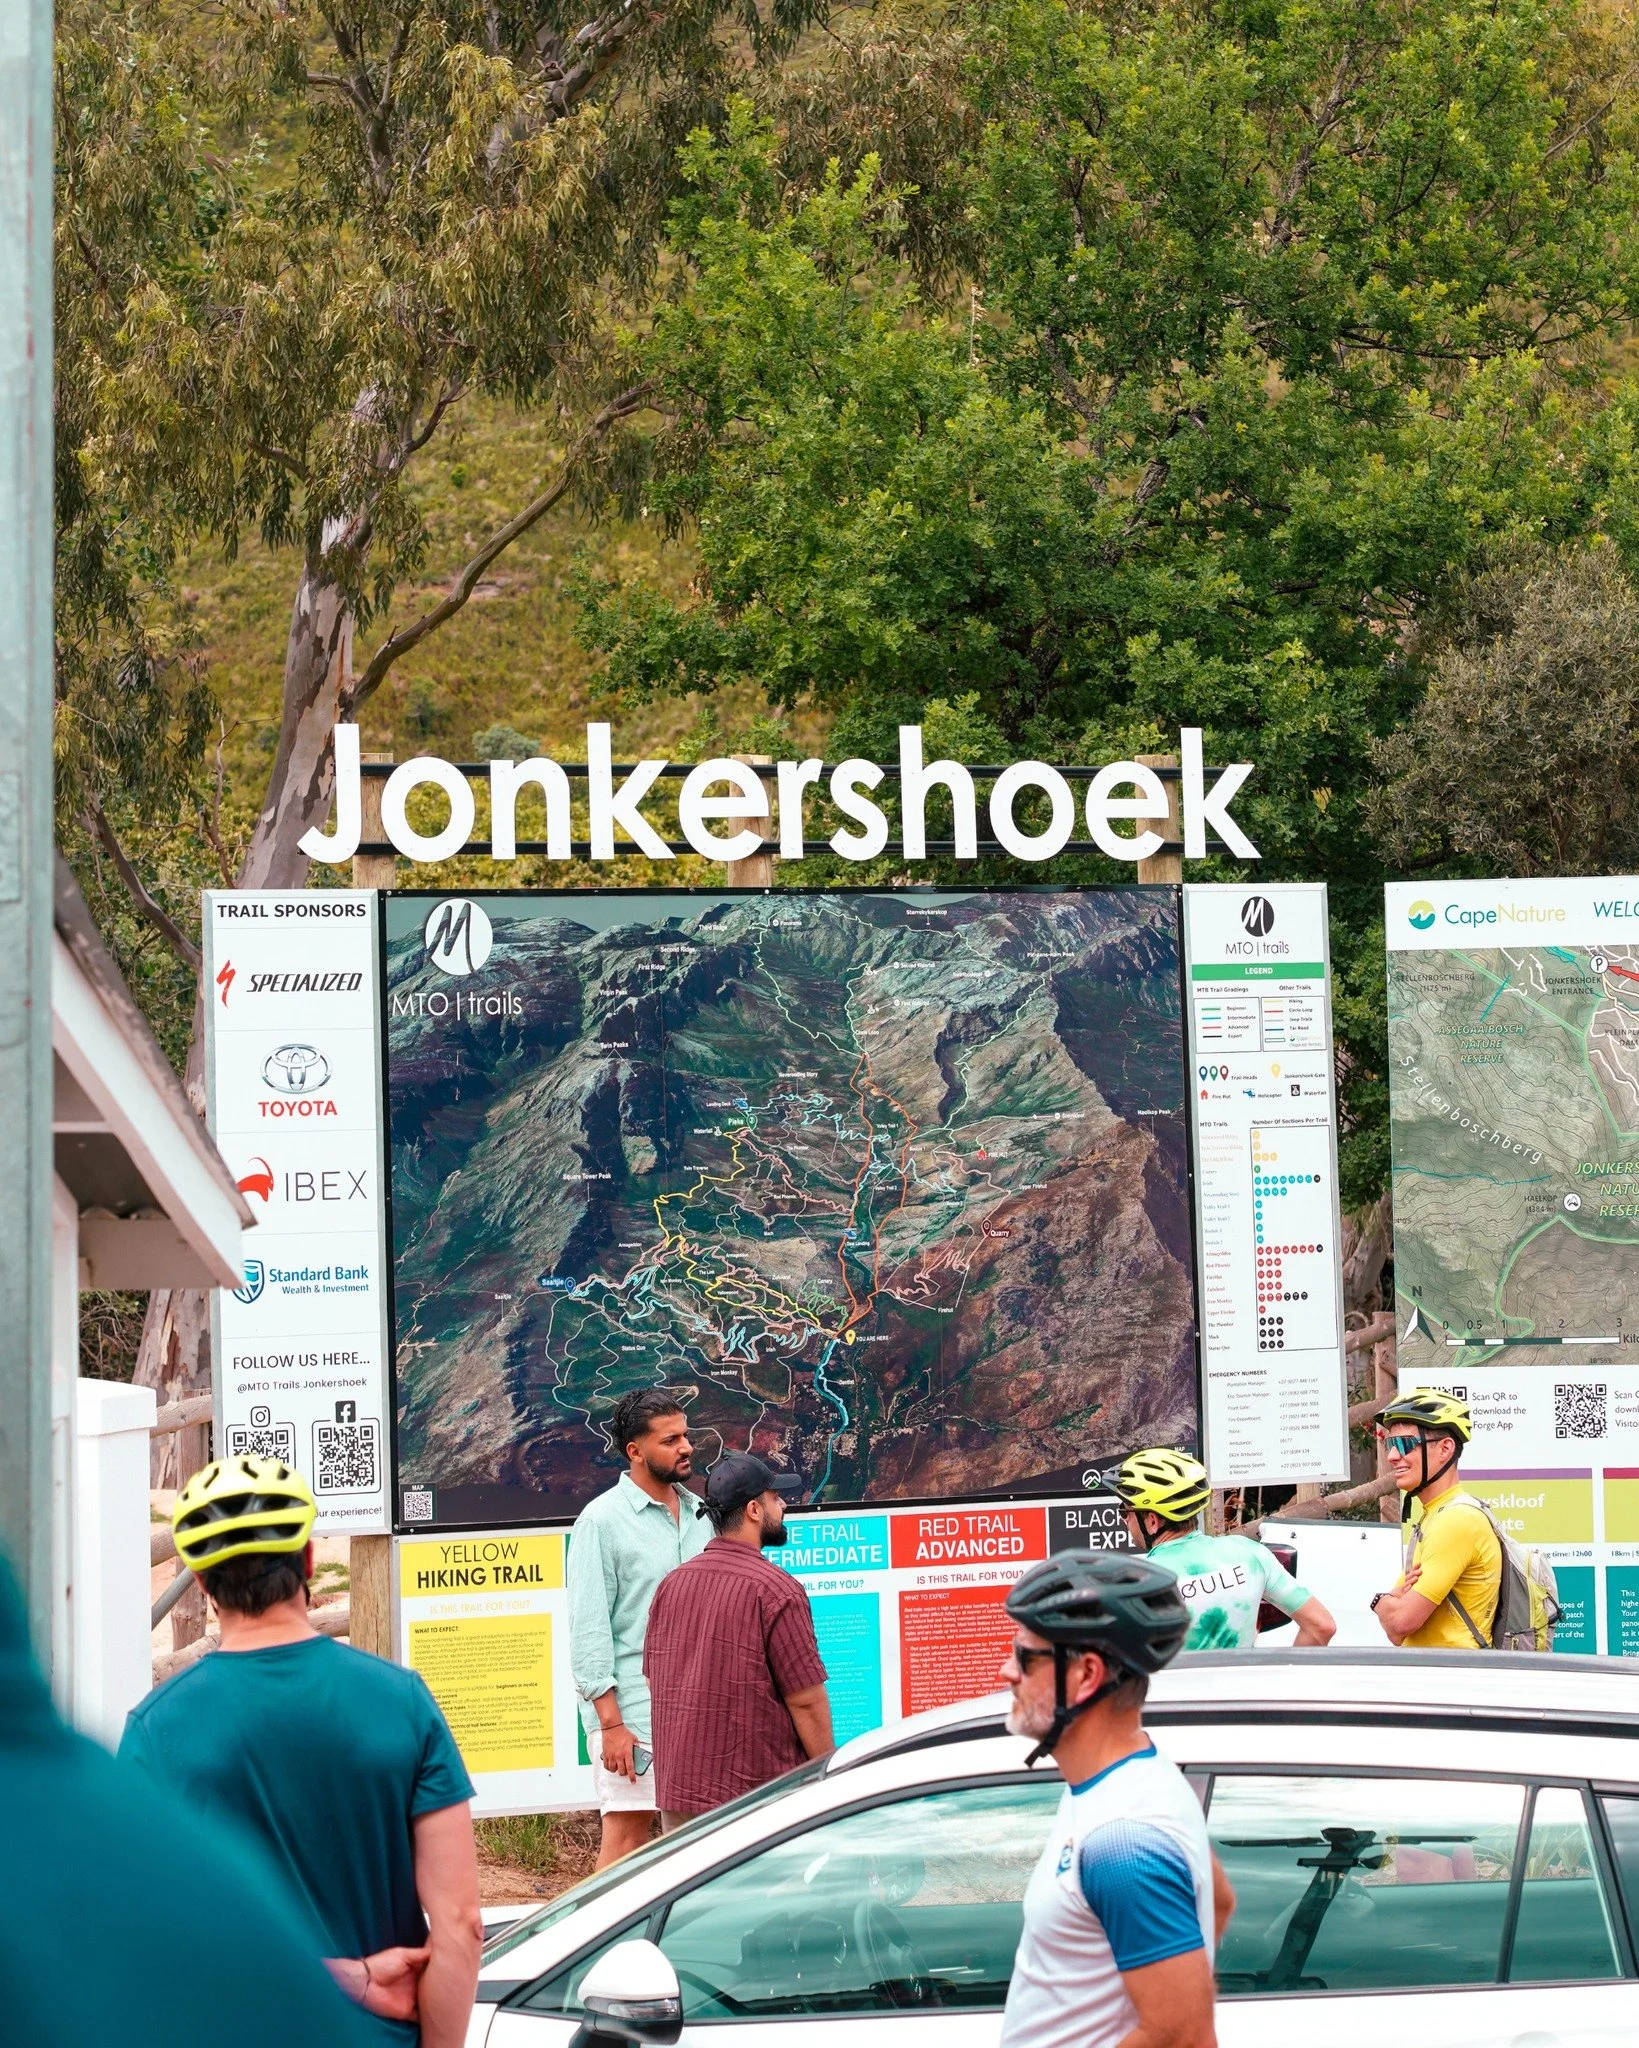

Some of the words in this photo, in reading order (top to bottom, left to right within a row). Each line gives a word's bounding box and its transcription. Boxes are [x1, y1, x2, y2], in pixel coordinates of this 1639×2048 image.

[298, 722, 1262, 864] Jonkershoek
[217, 904, 269, 918] TRAIL
[274, 904, 367, 917] SPONSORS
[1445, 904, 1566, 928] CapeNature
[1226, 942, 1253, 955] MTO
[1263, 941, 1290, 954] trails
[1245, 967, 1273, 975] LEGEND
[246, 972, 363, 993] SPECIALIZED
[1552, 987, 1594, 996] ENTRANCE
[392, 993, 449, 1017] MTO
[468, 991, 523, 1016] trails
[1461, 1039, 1502, 1049] NATURE
[1460, 1054, 1503, 1063] RESERVE
[258, 1100, 338, 1117] TOYOTA
[285, 1170, 368, 1202] IBEX
[269, 1266, 331, 1282] Standard
[335, 1265, 369, 1280] Bank
[282, 1285, 312, 1295] Wealth
[314, 1284, 321, 1293] &
[323, 1283, 370, 1293] Investment
[1411, 1286, 1422, 1297] N
[1443, 1321, 1449, 1330] 0
[1467, 1320, 1482, 1330] 0.5
[1502, 1320, 1506, 1329] 1
[1559, 1320, 1565, 1329] 2
[1616, 1318, 1623, 1327] 3
[233, 1355, 295, 1370] FOLLOW
[299, 1353, 318, 1367] US
[323, 1352, 370, 1366] HERE...
[237, 1382, 270, 1394] @MTO
[273, 1379, 300, 1390] Trails
[303, 1378, 367, 1389] Jonkershoek
[1472, 1393, 1490, 1401] Scan
[1492, 1392, 1507, 1401] QR
[1614, 1390, 1633, 1399] Scan
[1472, 1407, 1511, 1415] download
[1513, 1406, 1527, 1414] the
[1473, 1421, 1496, 1432] Forge
[1497, 1421, 1514, 1432] App
[331, 1506, 382, 1518] experience!
[919, 1518, 960, 1537] RED
[964, 1513, 1020, 1534] TRAIL
[809, 1522, 866, 1543] TRAIL
[440, 1542, 519, 1564] YELLOW
[915, 1536, 1025, 1561] ADVANCED
[417, 1567, 487, 1589] HIKING
[492, 1564, 544, 1586] TRAIL
[917, 1576, 926, 1585] IS
[928, 1574, 949, 1584] THIS
[951, 1573, 977, 1583] TRAIL
[979, 1571, 998, 1581] FOR
[1000, 1570, 1024, 1580] YOU?
[818, 1580, 837, 1590] FOR
[839, 1579, 865, 1589] YOU?
[1621, 1589, 1636, 1597] This
[1566, 1611, 1584, 1619] patch
[1621, 1609, 1637, 1617] Your
